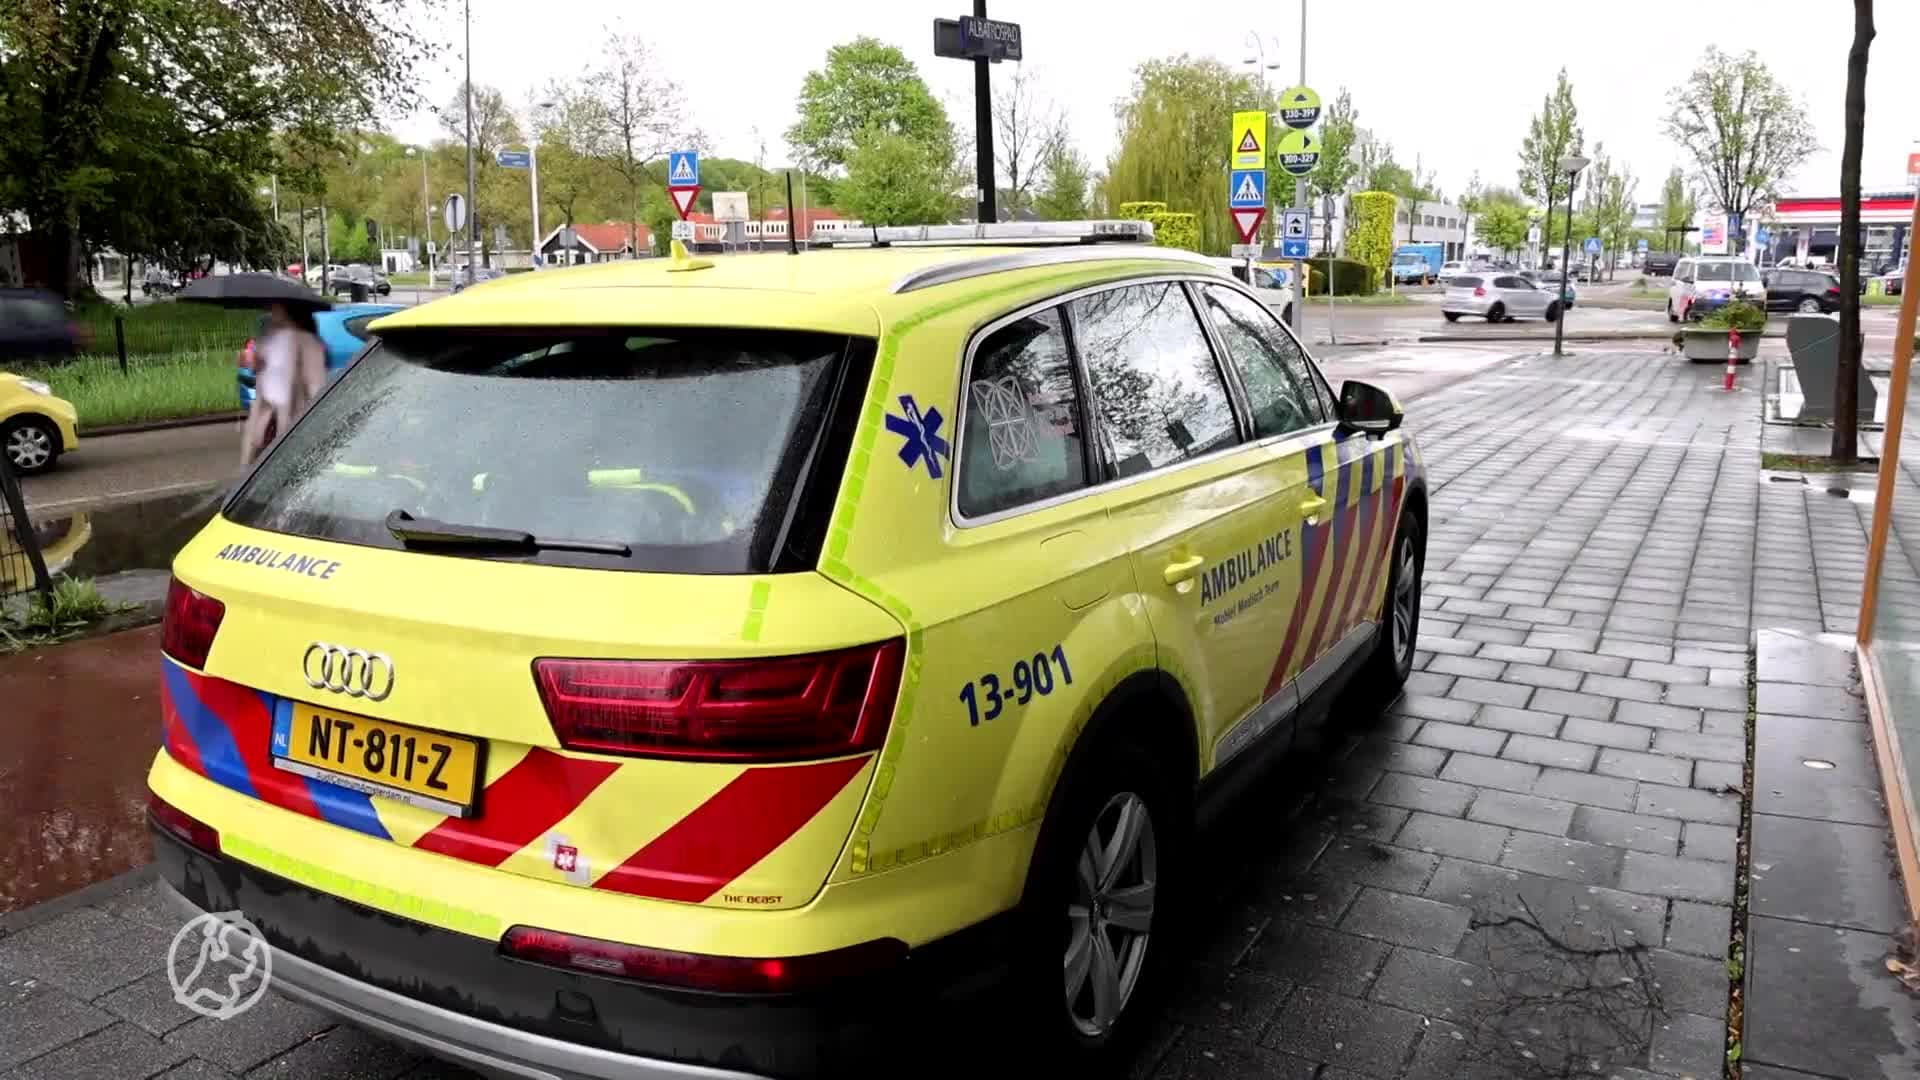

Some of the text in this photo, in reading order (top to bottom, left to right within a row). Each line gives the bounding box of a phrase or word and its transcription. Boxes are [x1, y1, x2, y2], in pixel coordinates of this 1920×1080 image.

[968, 20, 1018, 42] ALBATROSPAD
[215, 543, 342, 579] AMBULANCE
[1200, 528, 1293, 607] AMBULANCE
[959, 643, 1073, 727] 13-901
[274, 732, 287, 747] NL
[308, 714, 453, 791] NT-811-Z
[723, 894, 744, 903] THE
